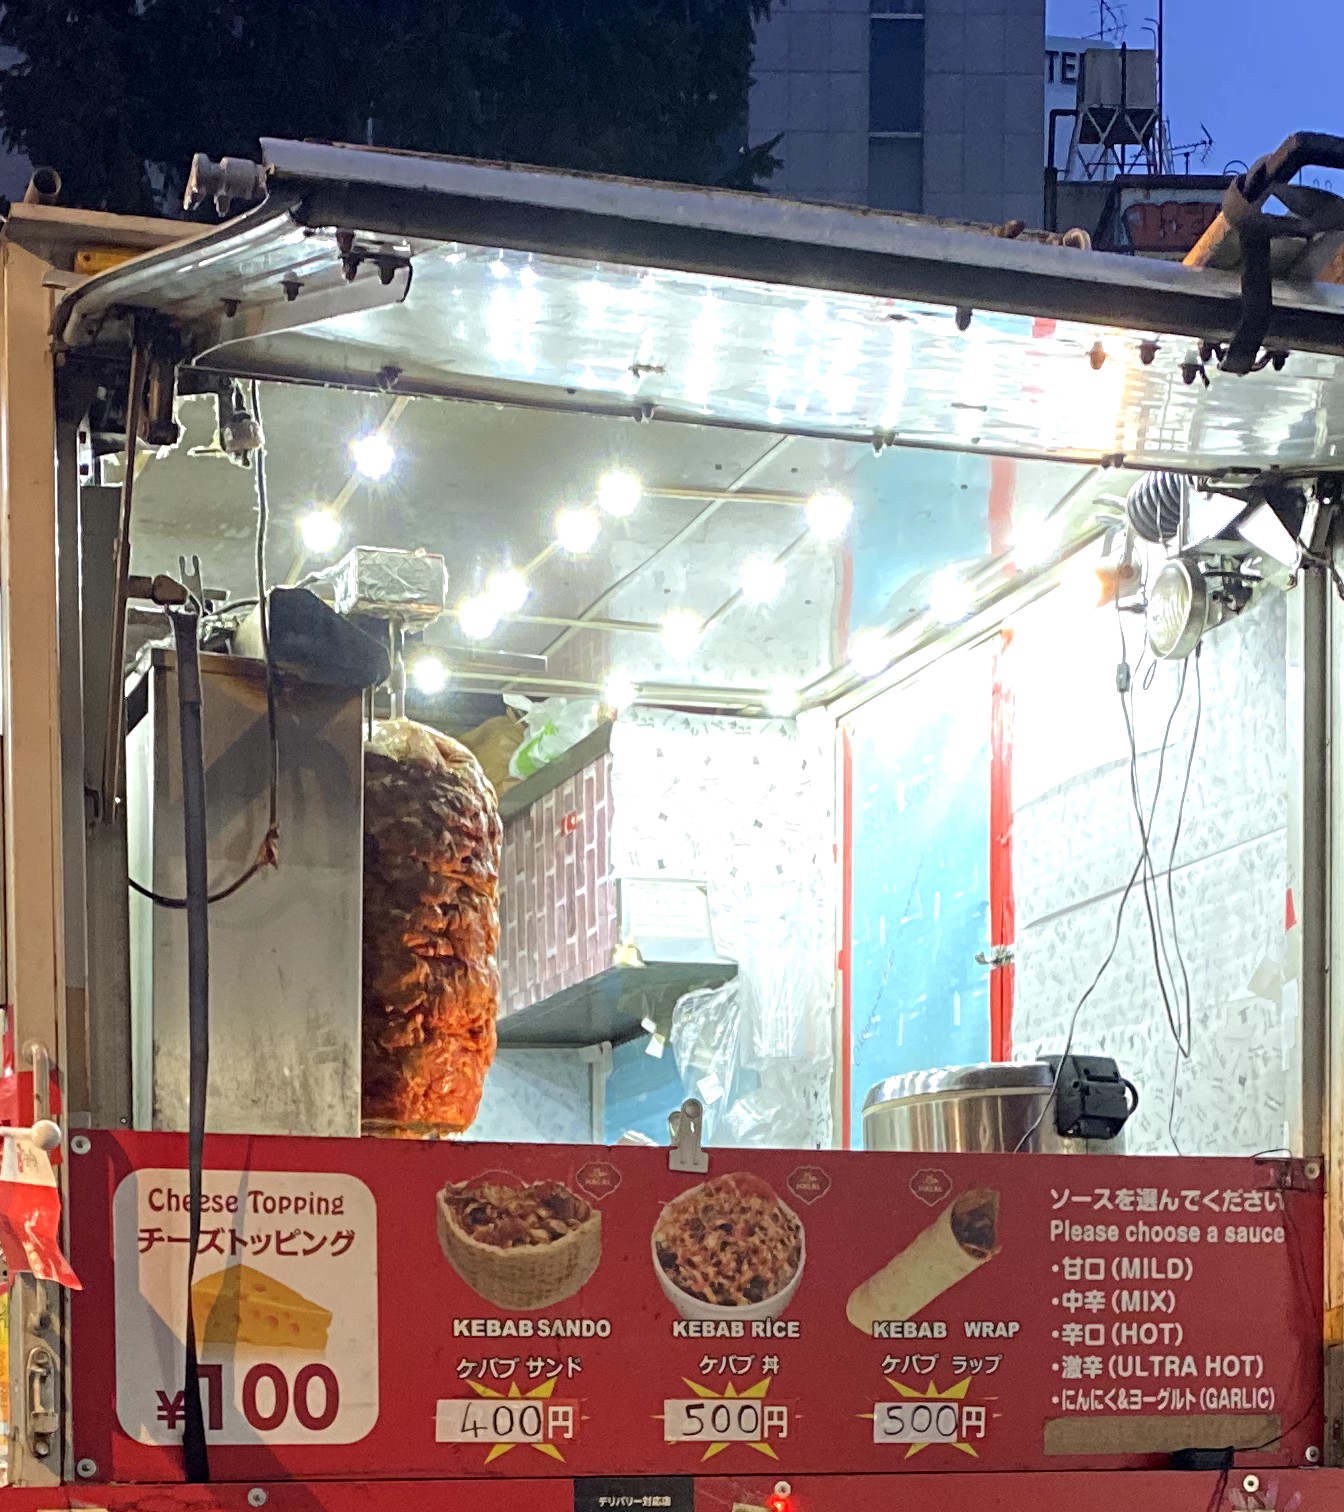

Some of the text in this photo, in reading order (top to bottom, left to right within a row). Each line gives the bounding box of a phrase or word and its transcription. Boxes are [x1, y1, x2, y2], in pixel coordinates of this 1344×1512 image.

[148, 1187, 345, 1216] Cheese Topping
[1050, 1188, 1285, 1213] ソースを選んでください
[137, 1227, 356, 1257] チーズトッピング
[1050, 1219, 1286, 1244] Please choose a sauce
[452, 1318, 612, 1339] KEBAB SANDO
[672, 1321, 745, 1338] KEBAB
[872, 1322, 1020, 1339] KEBAB WRAP
[456, 1356, 583, 1379] ケバブ サンド
[699, 1355, 779, 1376] ケバブ 丼
[881, 1353, 1003, 1376] ケバブ ラップ
[1205, 1354, 1264, 1380] HOT)
[155, 1362, 340, 1432] ¥100
[460, 1401, 574, 1440] 400円
[681, 1402, 788, 1439] 500円
[883, 1403, 987, 1439] 500円
